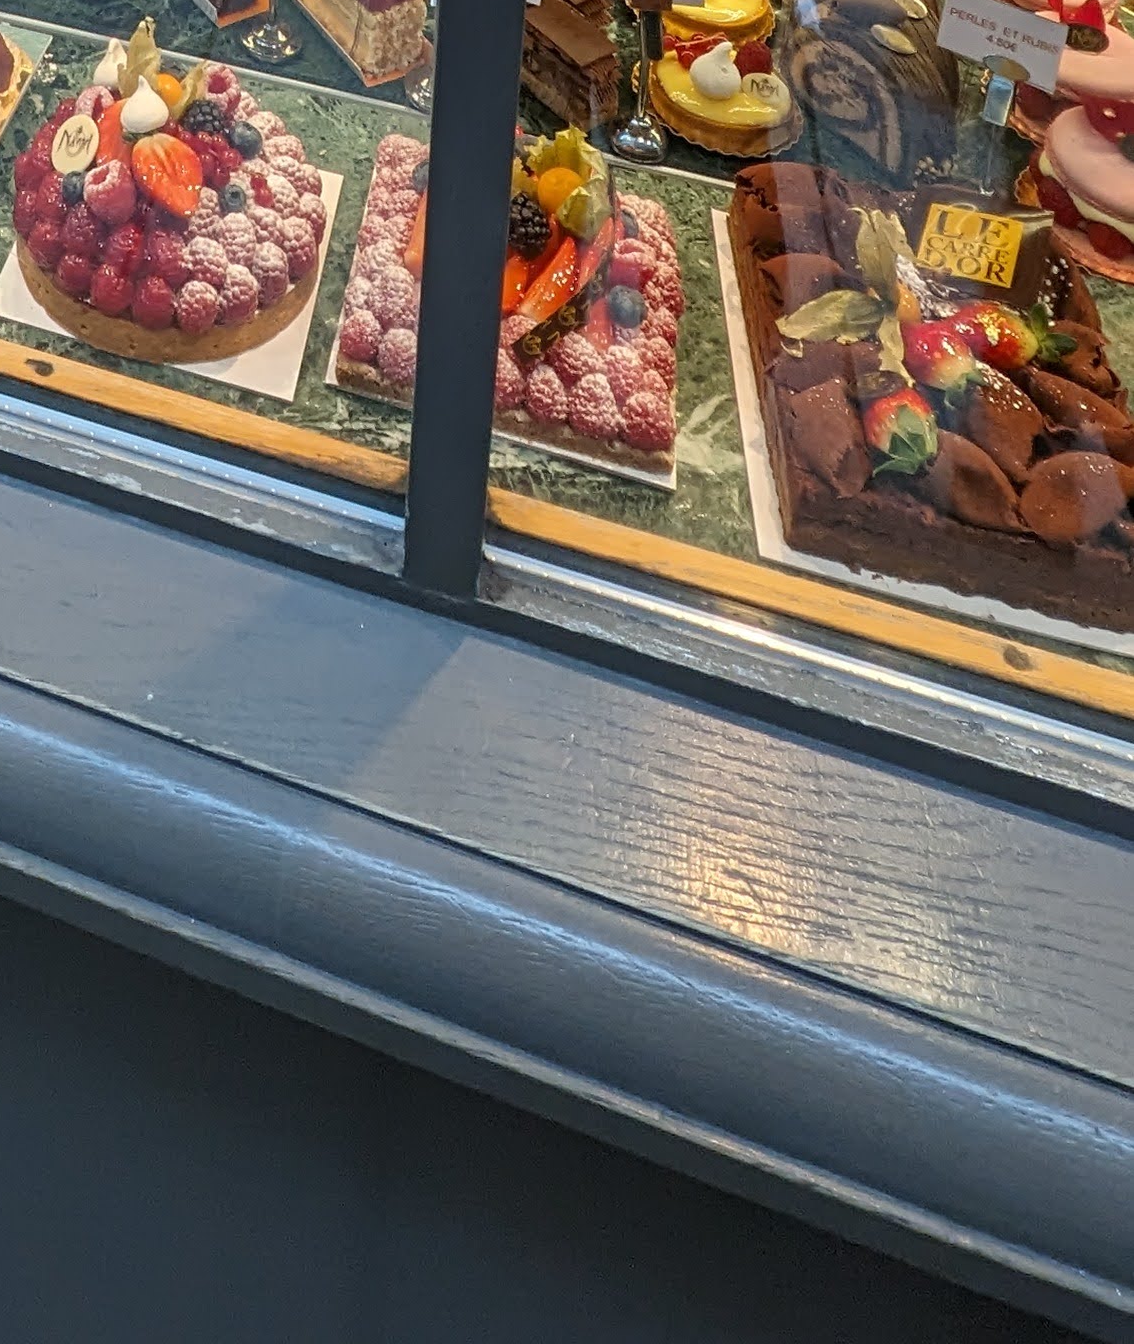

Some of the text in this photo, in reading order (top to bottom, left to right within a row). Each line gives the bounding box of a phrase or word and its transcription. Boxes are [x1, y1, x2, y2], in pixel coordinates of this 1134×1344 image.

[950, 7, 997, 31] PERLES
[1003, 26, 1018, 39] ET
[936, 208, 1010, 249] LE
[926, 235, 1010, 265] CARRE
